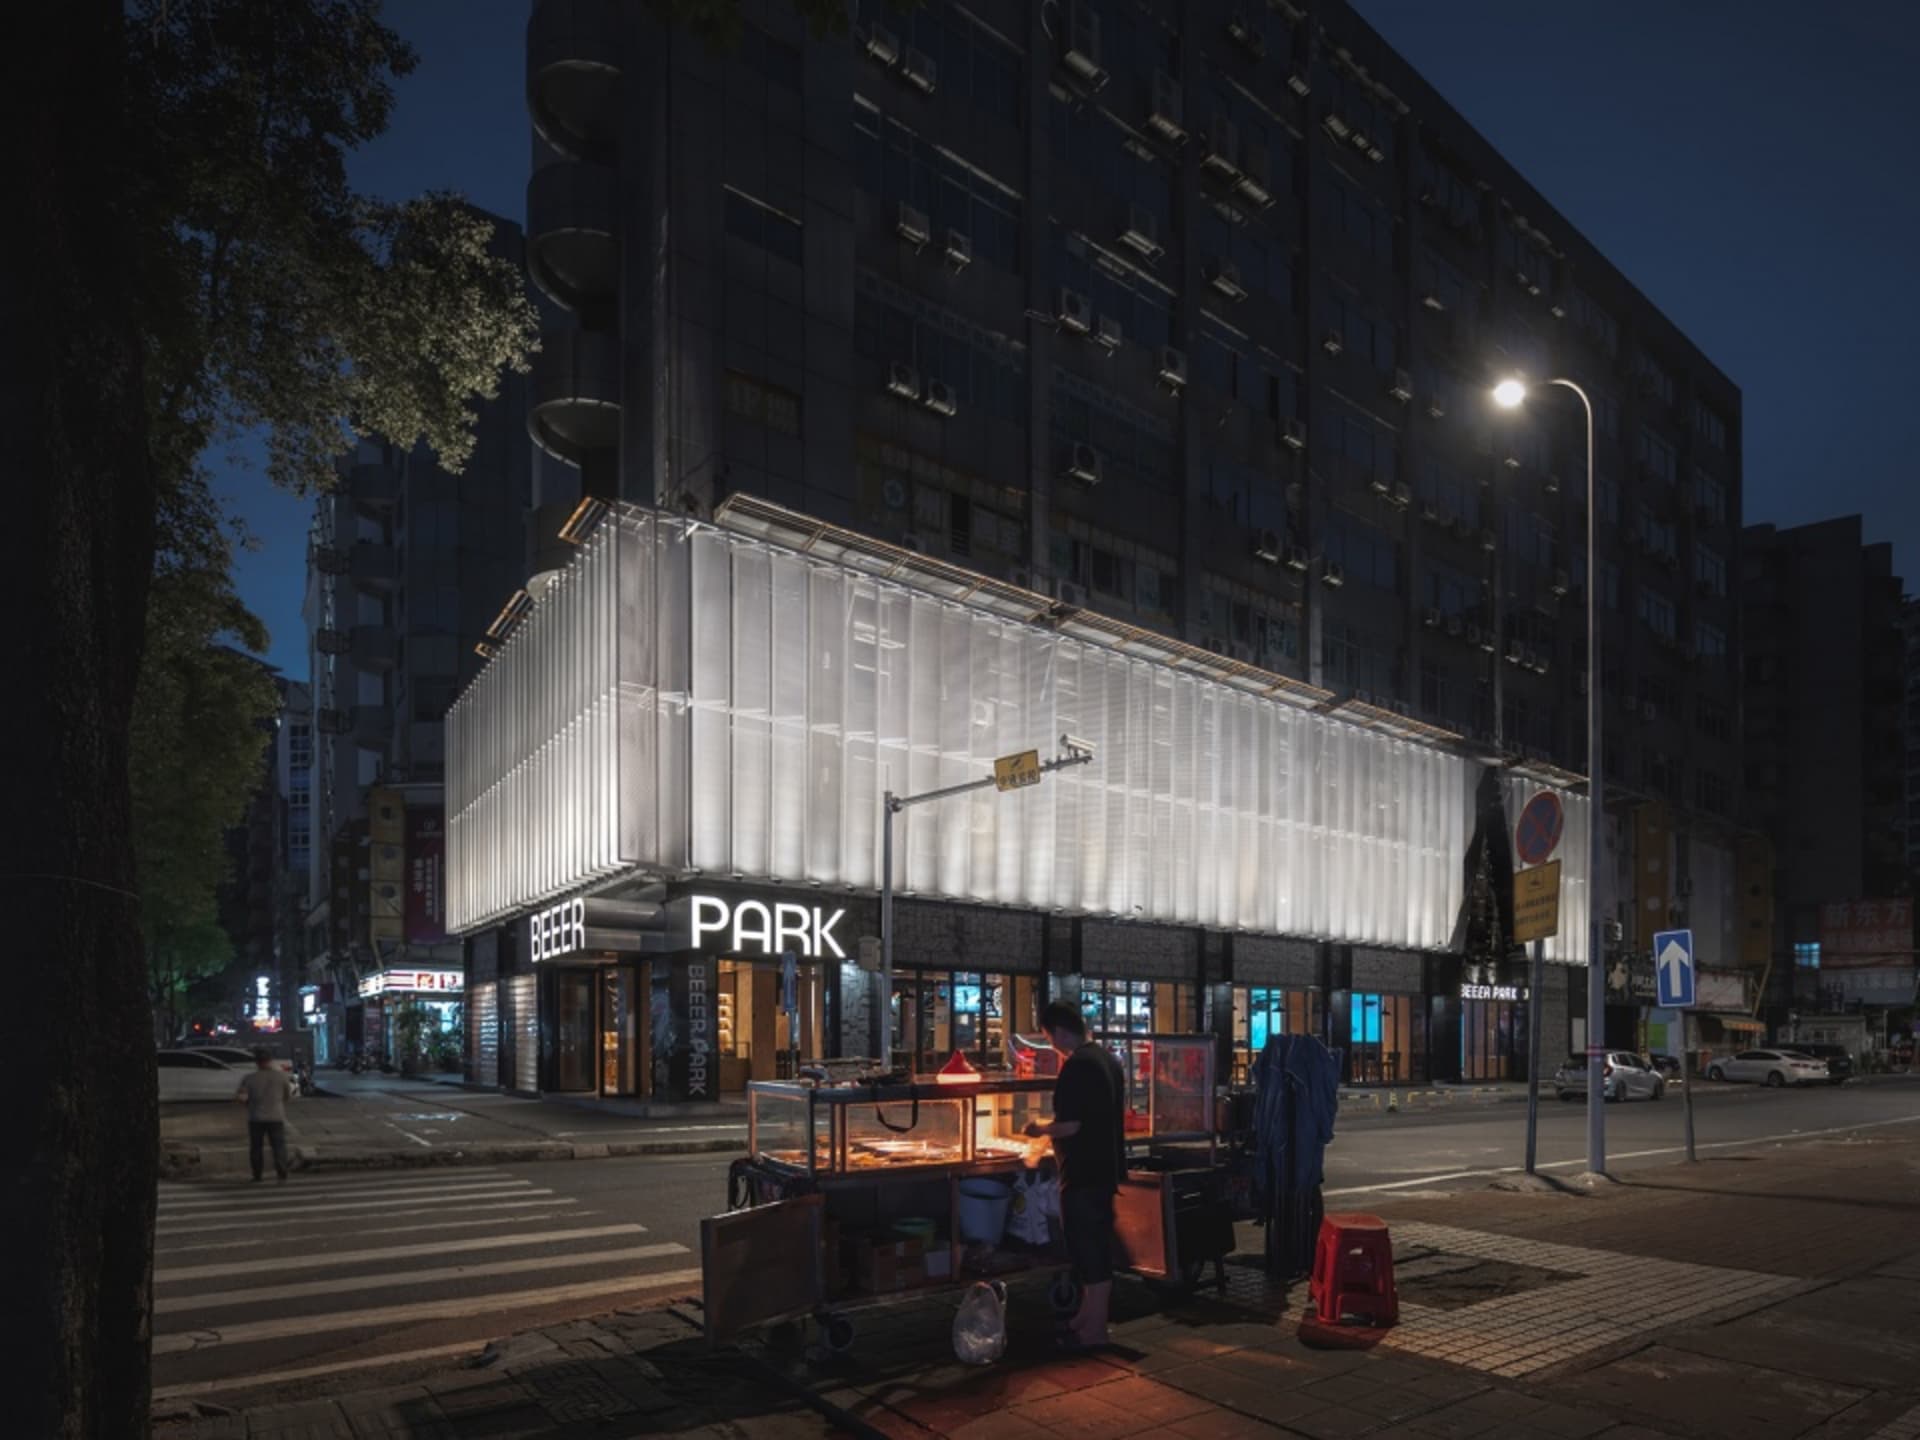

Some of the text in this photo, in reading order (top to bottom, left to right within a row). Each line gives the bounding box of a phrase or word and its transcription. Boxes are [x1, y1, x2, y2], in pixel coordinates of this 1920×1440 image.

[531, 895, 846, 963] BEEER PARK
[687, 964, 709, 1097] BEEER PARK
